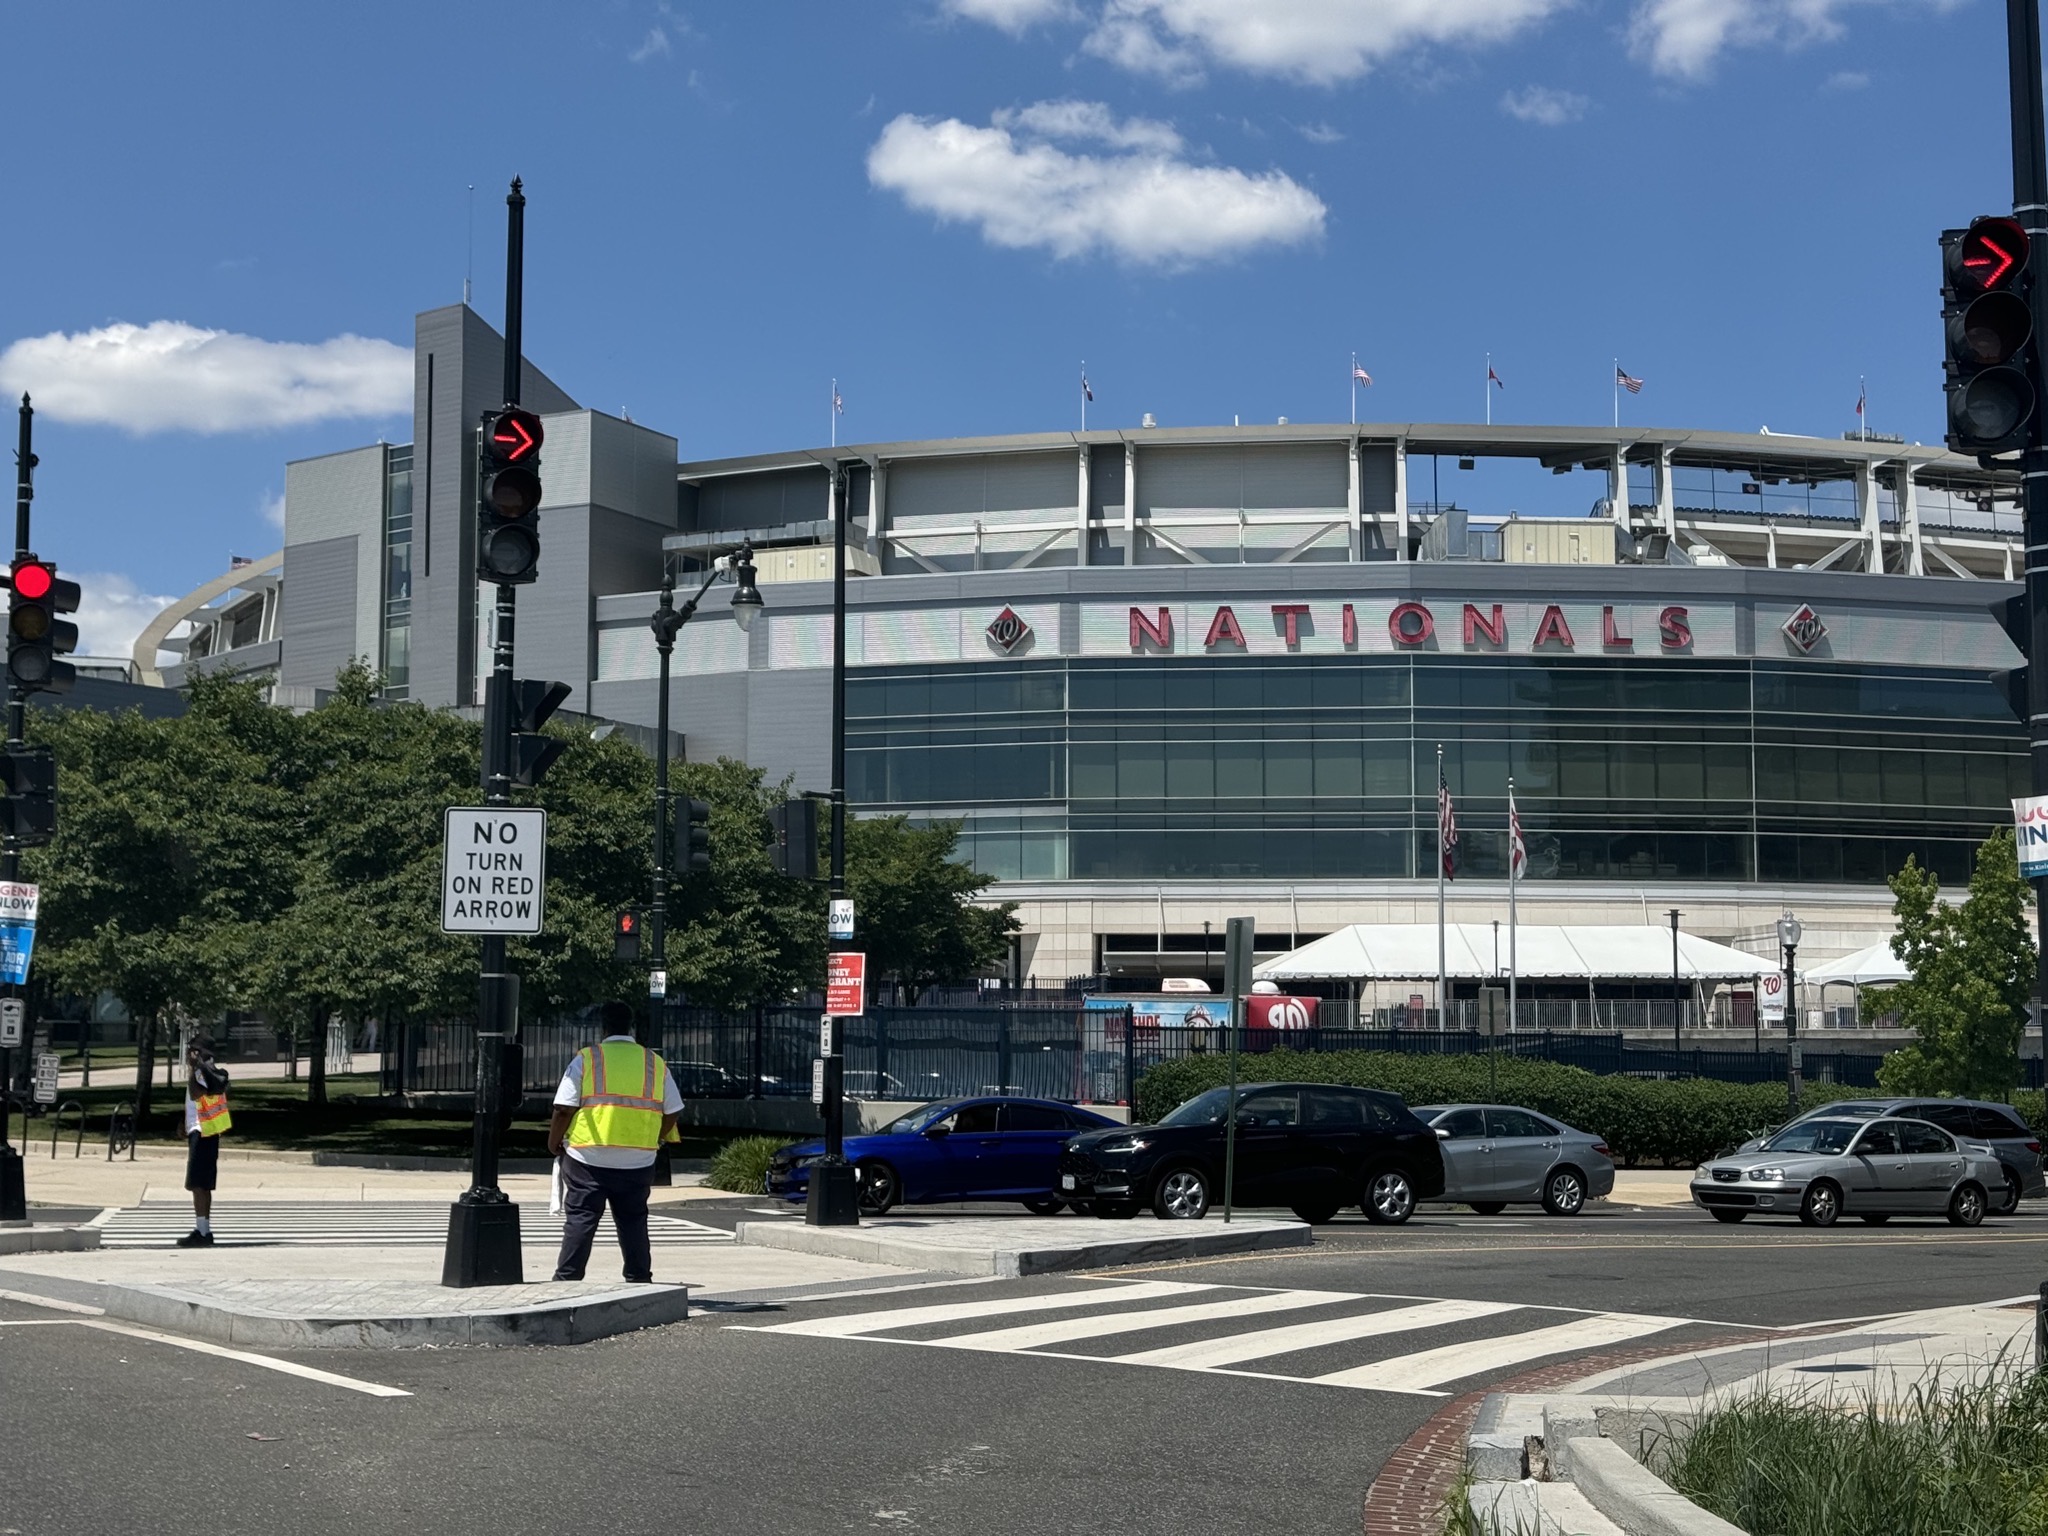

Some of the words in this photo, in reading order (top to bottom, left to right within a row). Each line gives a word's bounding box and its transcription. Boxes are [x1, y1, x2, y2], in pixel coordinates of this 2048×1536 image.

[1129, 602, 1691, 648] NATIONALS
[474, 822, 517, 844] NO
[466, 852, 522, 871] TURN
[452, 876, 481, 894] ON
[492, 876, 534, 895] RED
[453, 900, 531, 918] ARROW
[828, 977, 861, 986] GRANT
